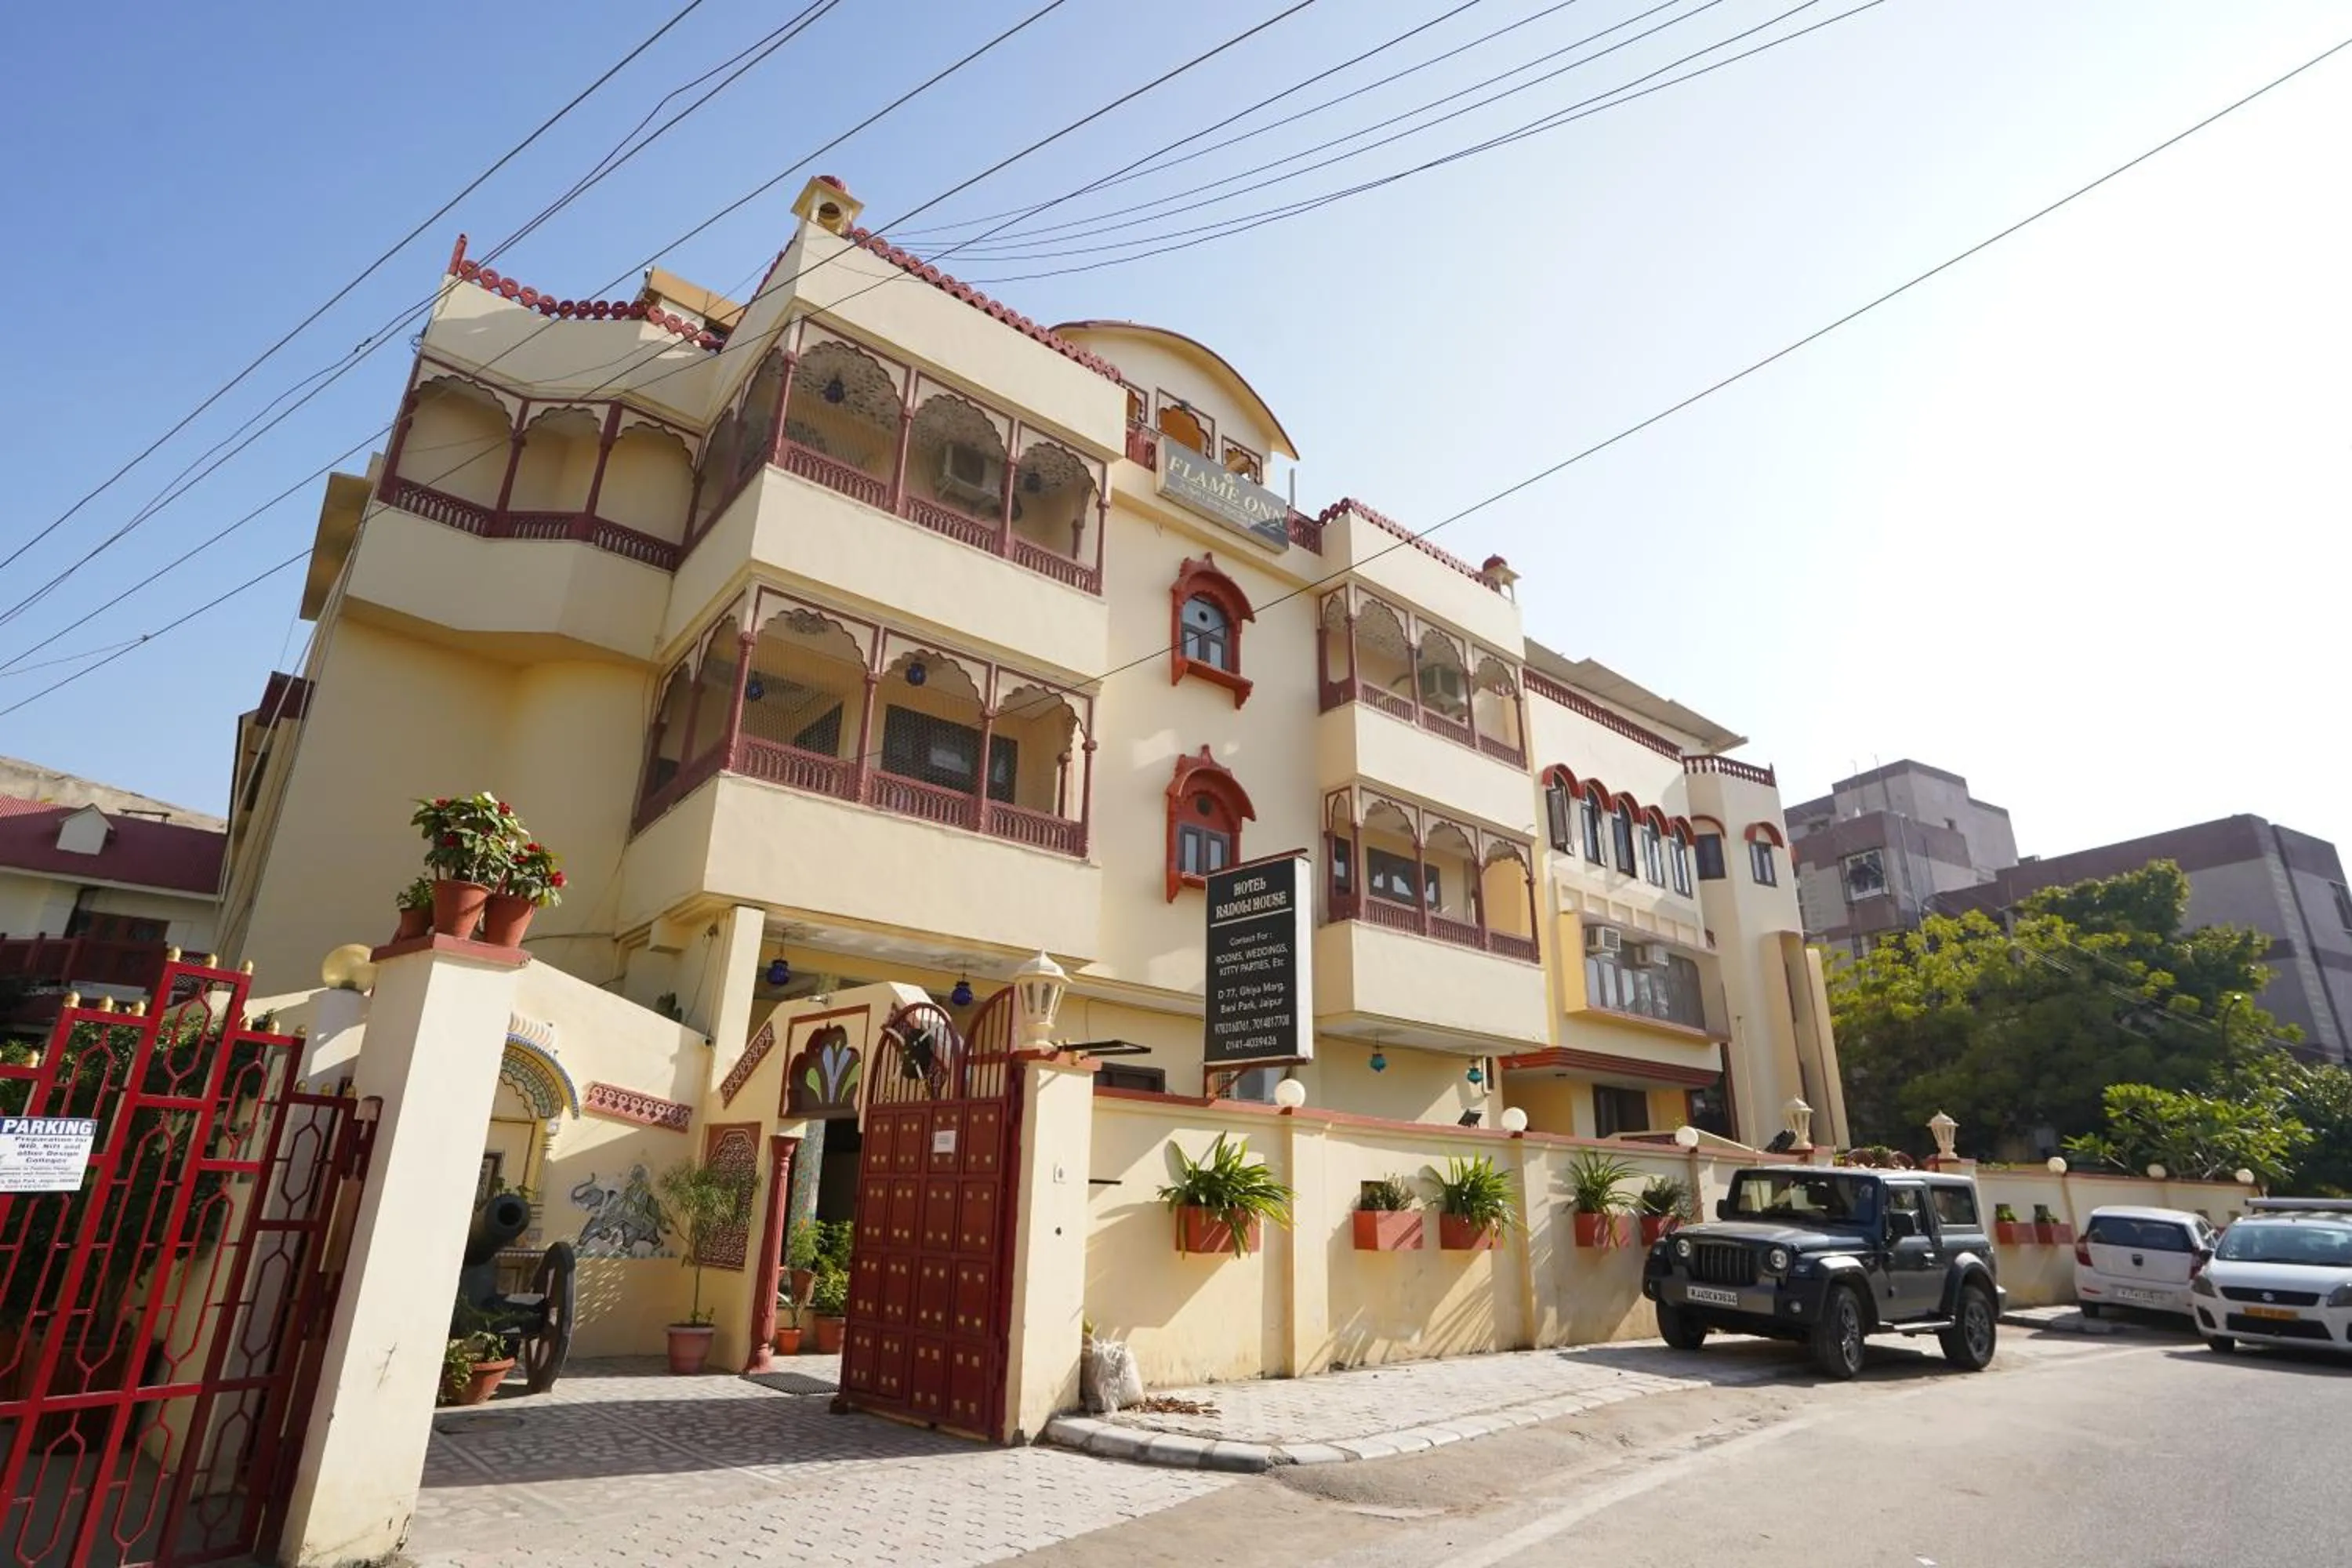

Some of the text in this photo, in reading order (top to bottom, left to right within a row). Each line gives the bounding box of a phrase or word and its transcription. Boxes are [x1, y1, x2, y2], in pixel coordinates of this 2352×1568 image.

[1169, 455, 1240, 505] FLAME
[1233, 877, 1267, 897] HOTEL
[1219, 964, 1239, 977] KITTY
[2, 1119, 93, 1135] PARKING
